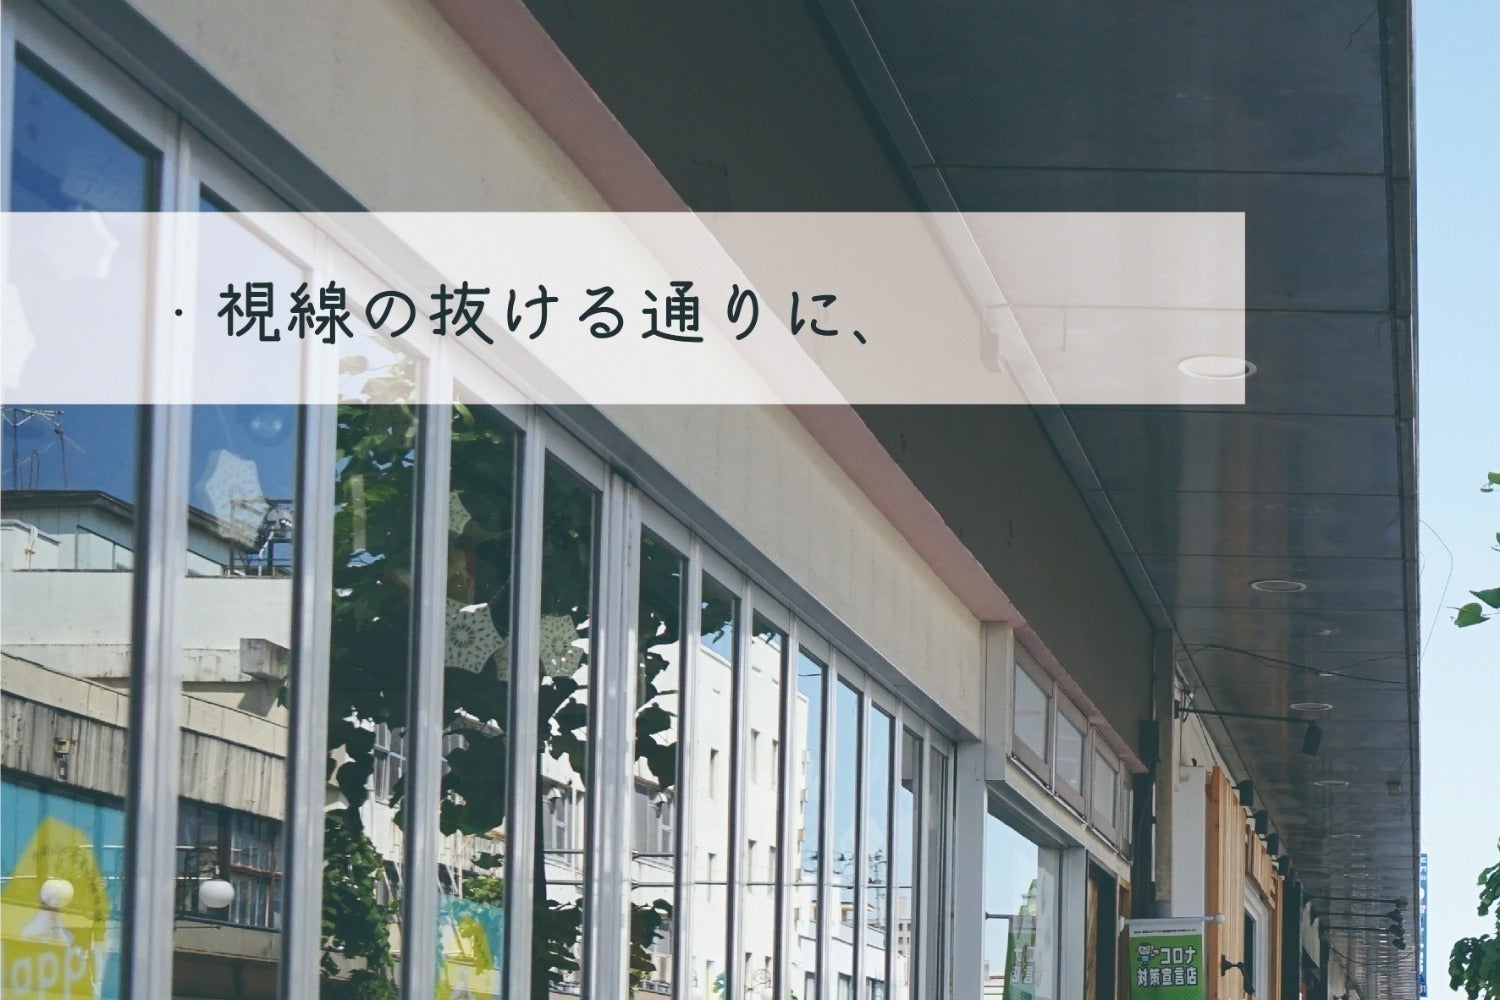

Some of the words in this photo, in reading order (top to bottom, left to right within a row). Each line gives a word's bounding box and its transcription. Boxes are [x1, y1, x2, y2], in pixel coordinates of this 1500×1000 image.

[1160, 946, 1198, 966] コロナ
[1136, 966, 1198, 987] 対策宣言店
